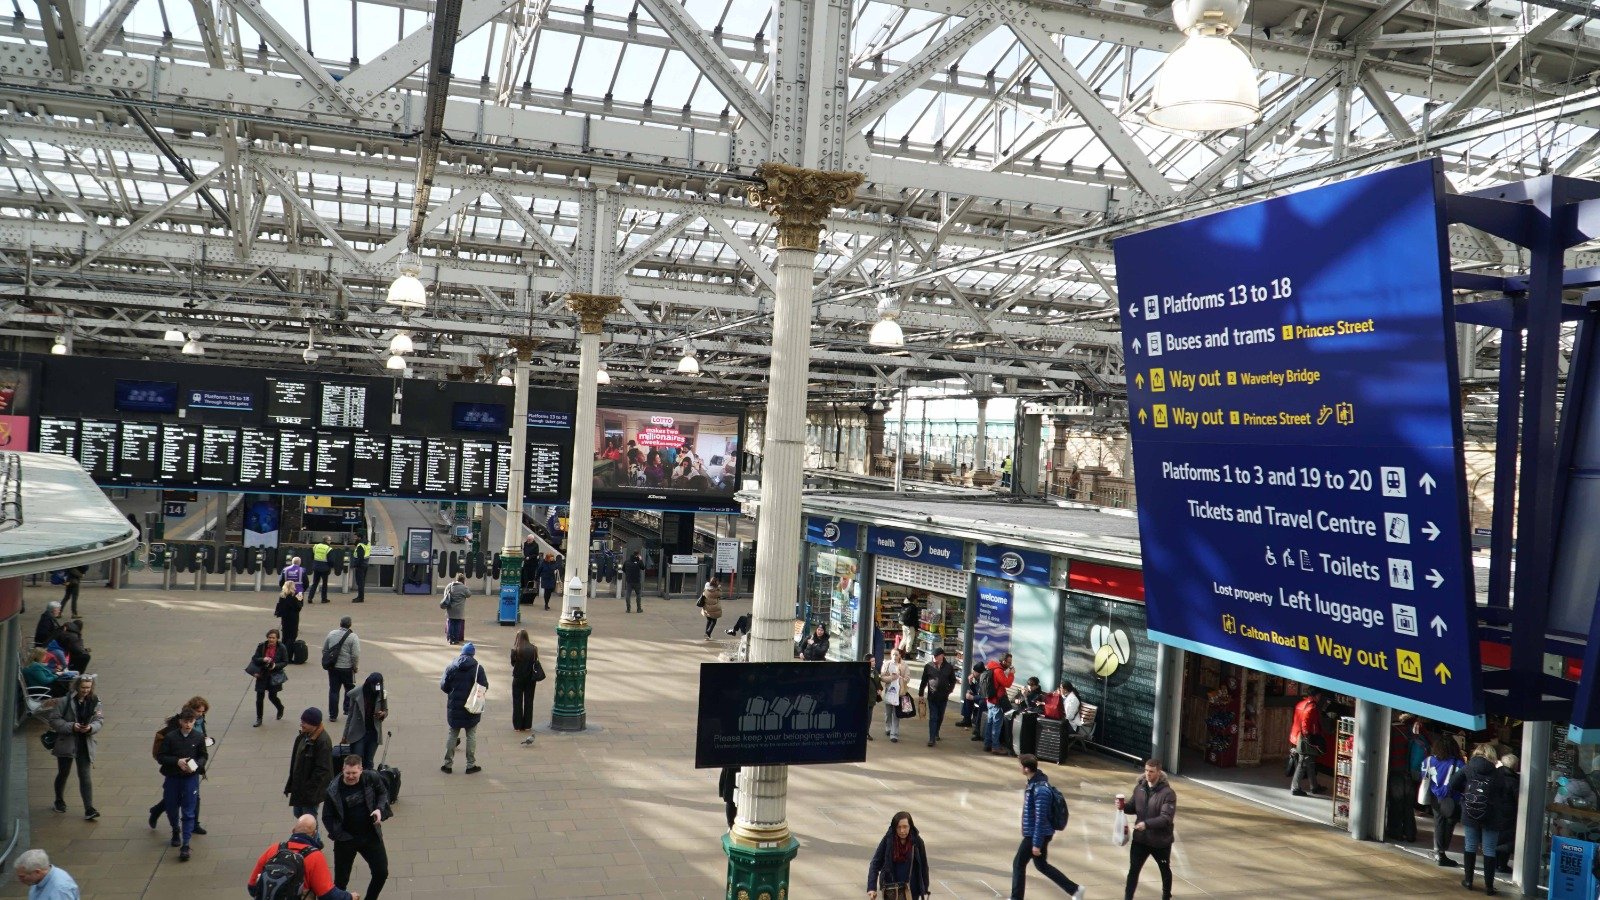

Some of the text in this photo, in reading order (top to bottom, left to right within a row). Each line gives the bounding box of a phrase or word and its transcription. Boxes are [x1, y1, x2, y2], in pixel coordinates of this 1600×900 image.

[1164, 277, 1292, 314] Platforms 13 to 18
[1296, 324, 1334, 338] Princes
[1337, 318, 1374, 335] Street
[1166, 328, 1276, 351] Buses and trams
[1170, 370, 1221, 391] Way out
[1241, 370, 1284, 386] Waverley
[1286, 368, 1320, 383] Bridge
[204, 394, 227, 402] Platforms
[1172, 408, 1224, 429] Way out
[1244, 414, 1278, 425] Princes
[1280, 412, 1312, 425] Street
[639, 432, 686, 443] millionaires
[1162, 461, 1372, 491] Platforms 1 to 3 and 19 to 20
[170, 505, 180, 514] 14
[345, 511, 356, 520] 15
[1188, 500, 1377, 536] Tickets and Travel Centre
[878, 537, 895, 548] health
[928, 546, 950, 559] beauty
[1319, 552, 1380, 581] Toilets
[980, 593, 1008, 605] welcome
[1214, 582, 1384, 628] Lost property Left luggage
[1240, 624, 1270, 642] Calton
[1272, 631, 1296, 648] Road
[1316, 636, 1352, 665] Way
[1356, 650, 1388, 670] out
[714, 734, 741, 743] Please
[743, 734, 762, 743] keep
[783, 732, 824, 741] belongings
